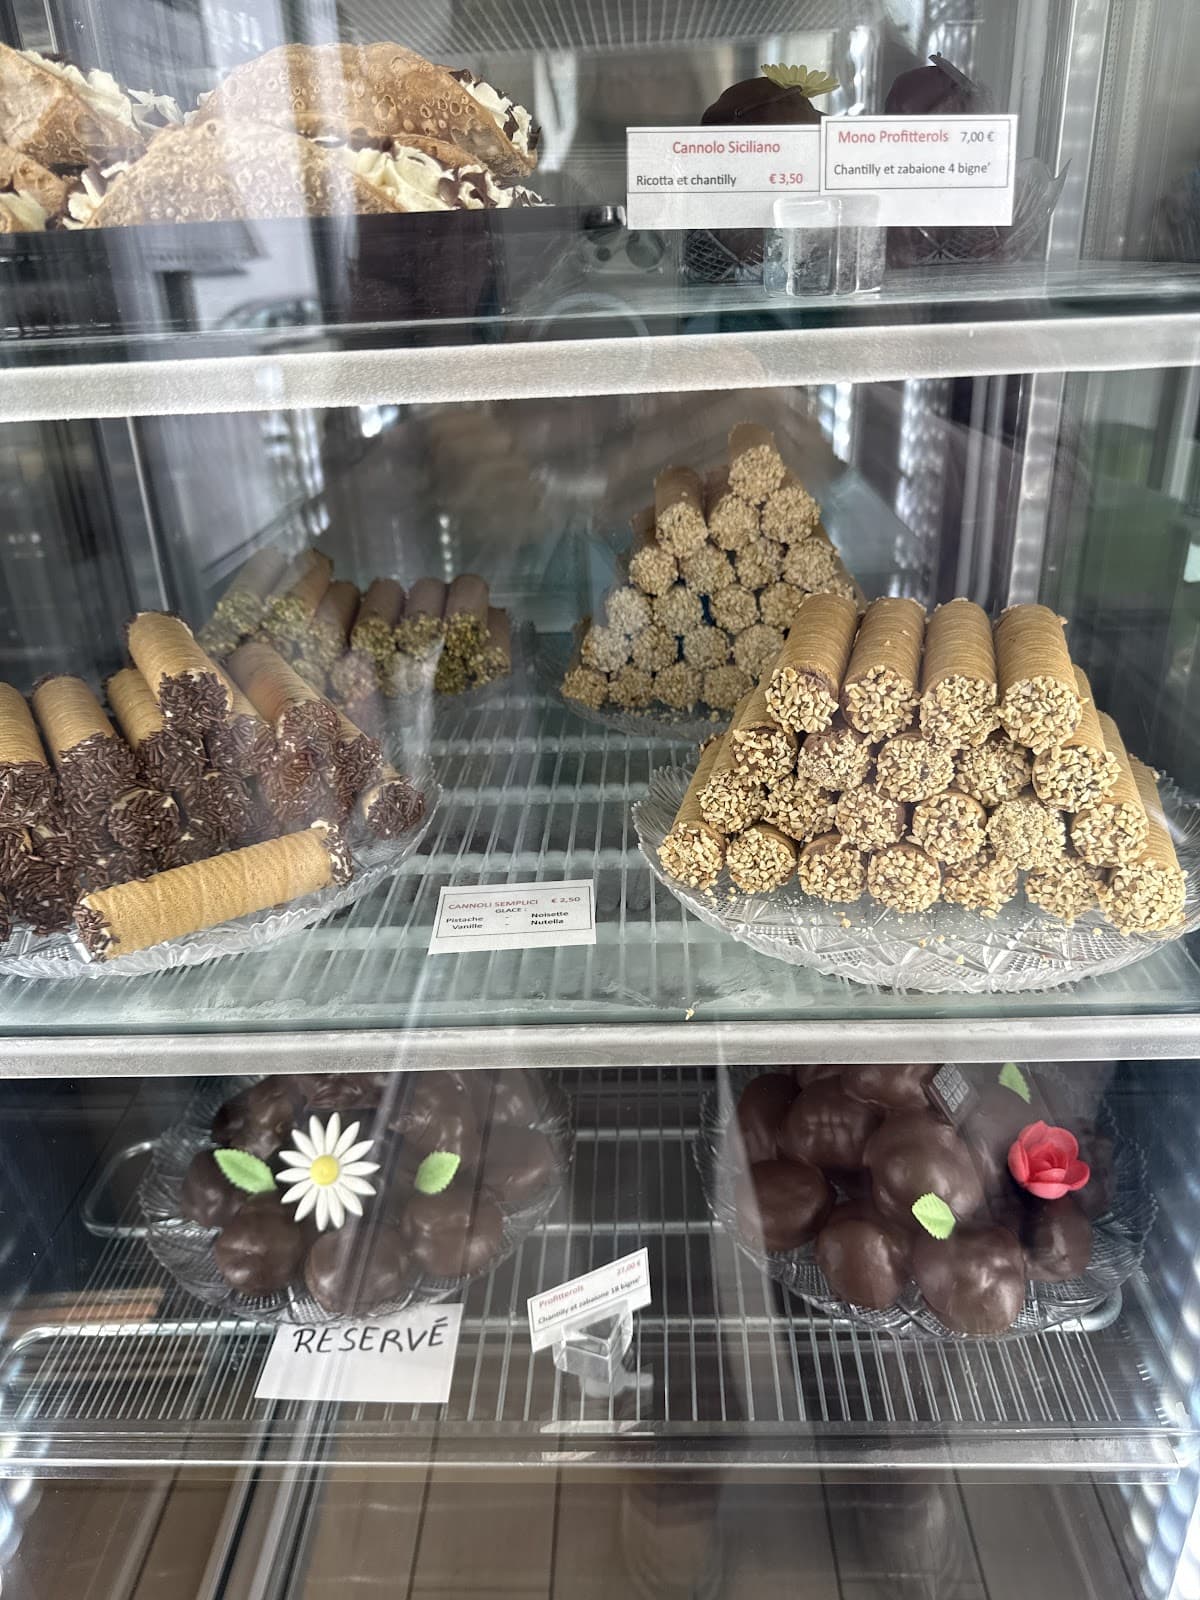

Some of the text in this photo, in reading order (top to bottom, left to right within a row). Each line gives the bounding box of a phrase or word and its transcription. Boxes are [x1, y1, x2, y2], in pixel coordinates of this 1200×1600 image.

[838, 130, 995, 144] Mono Profitterols 7,00 €
[672, 140, 781, 154] Cannolo Siciliano
[833, 164, 881, 176] Chantilly
[884, 165, 894, 175] et
[897, 163, 945, 175] zabaione
[948, 163, 955, 173] 4
[636, 173, 803, 187] Ricotta et chantilly € 3,50
[448, 902, 492, 910] CANNOLI
[494, 899, 539, 907] SEMPLICI
[452, 922, 483, 930] Vanille
[531, 918, 564, 926] Nutella
[539, 1285, 584, 1308] Profitterols
[293, 1316, 449, 1353] RESERVÉ
